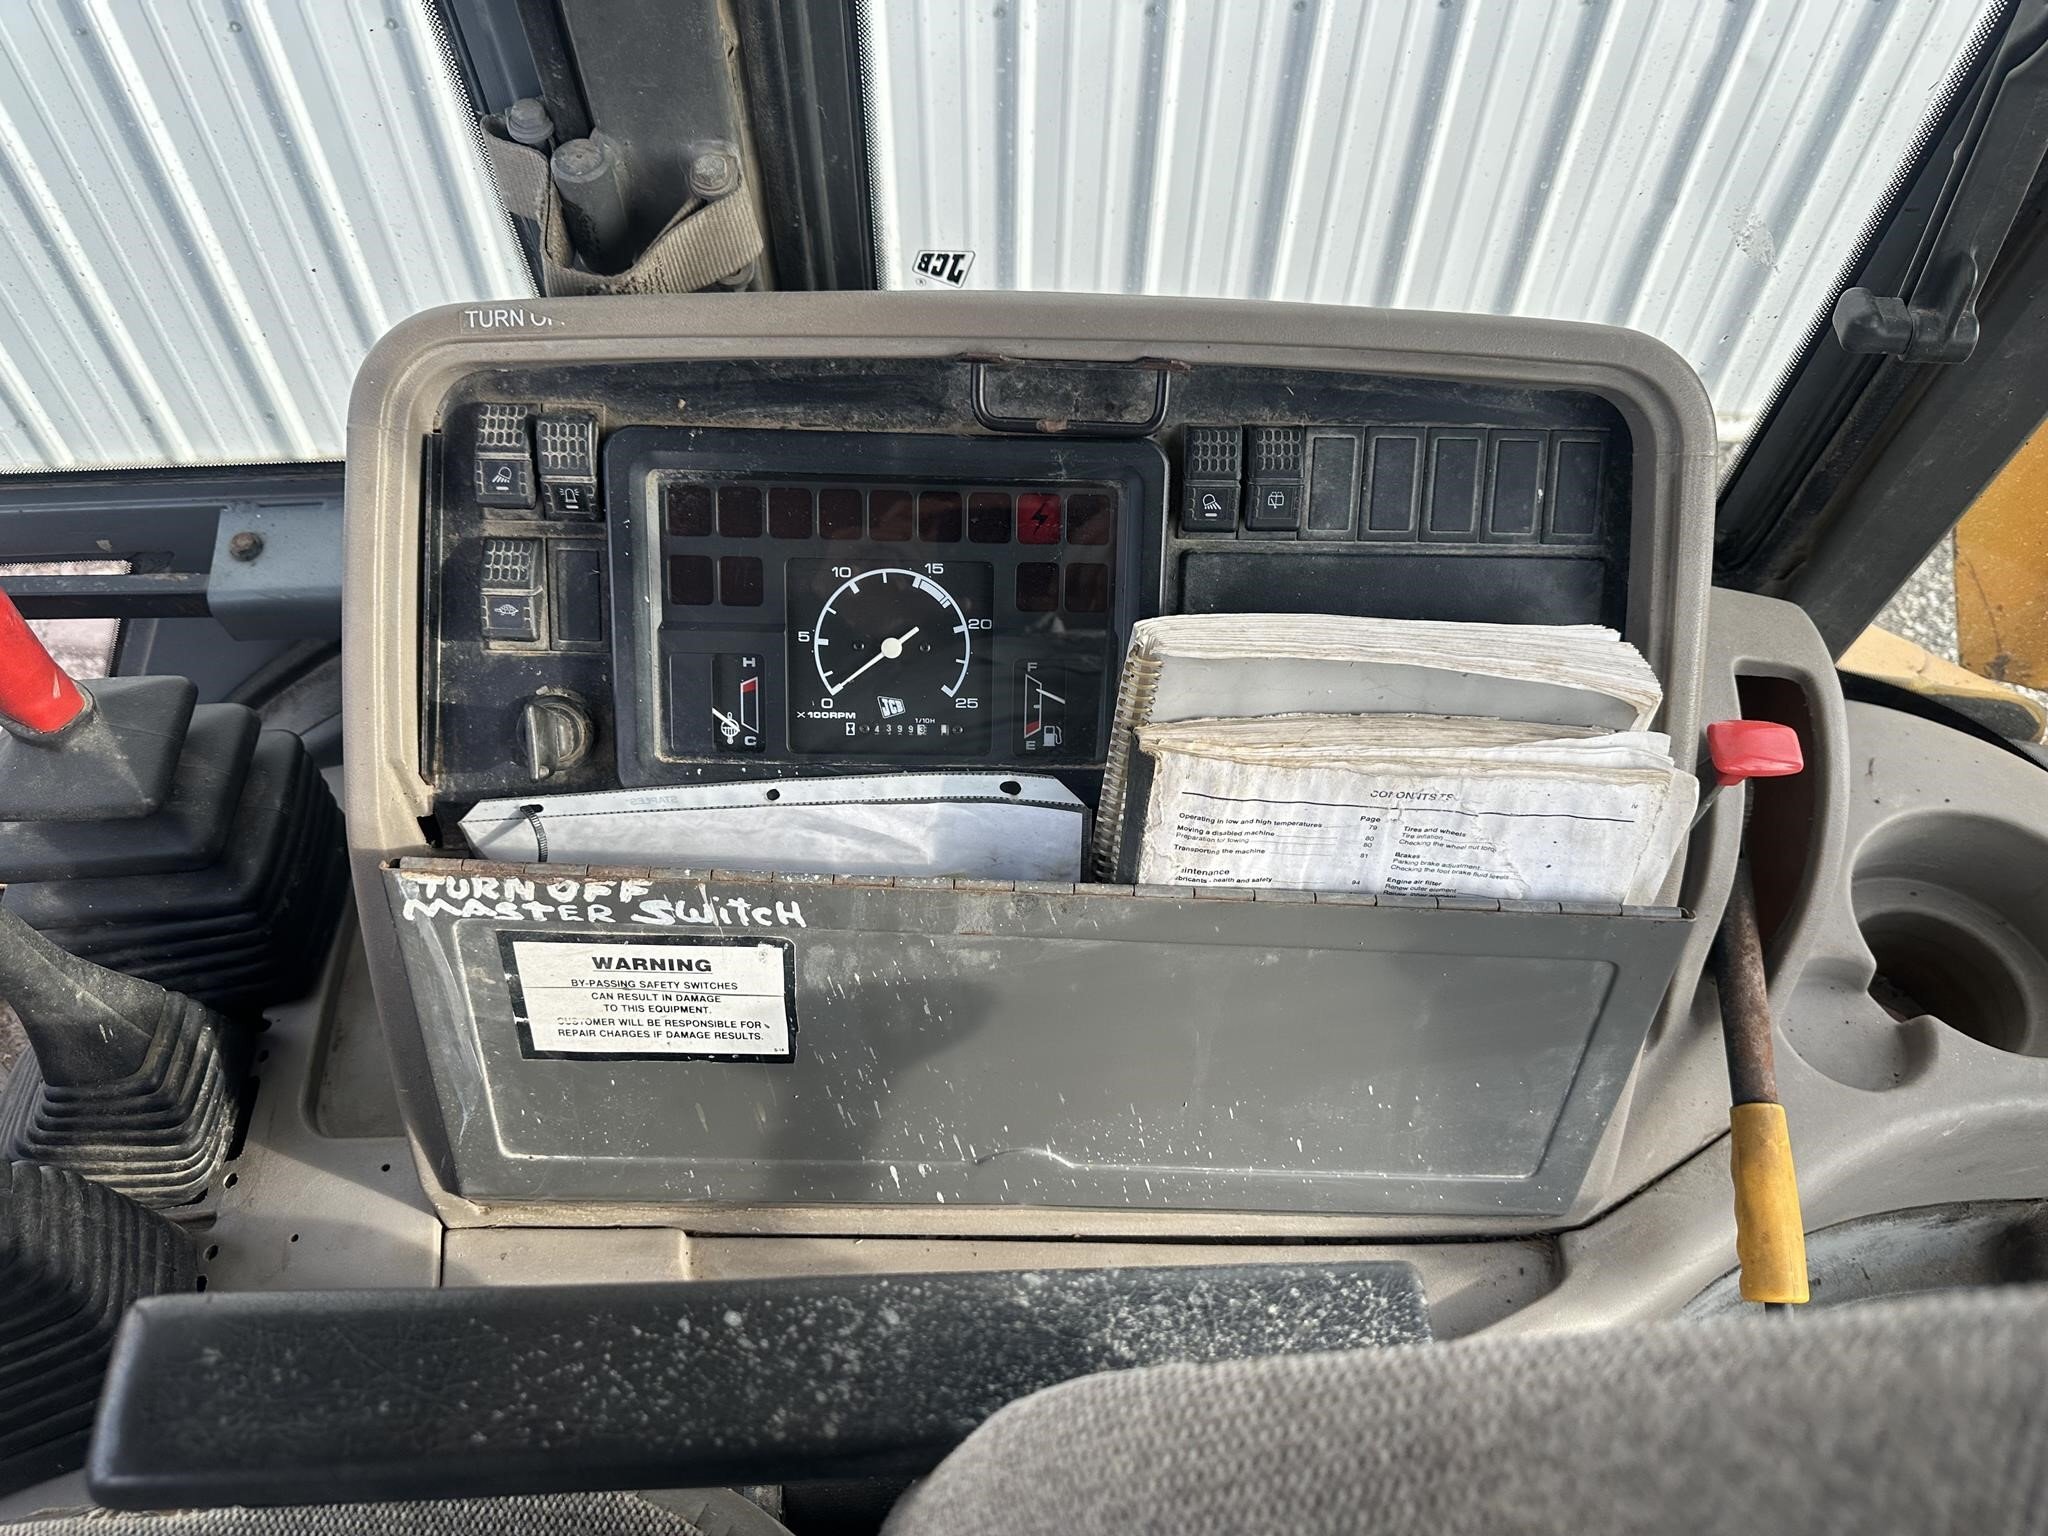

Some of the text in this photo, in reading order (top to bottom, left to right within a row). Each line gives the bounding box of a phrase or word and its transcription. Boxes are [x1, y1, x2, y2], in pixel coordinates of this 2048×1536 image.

[464, 309, 524, 328] TURN
[831, 567, 852, 578] 10
[924, 563, 944, 574] 15
[968, 618, 992, 630] 20
[798, 632, 810, 642] 5
[742, 657, 756, 667] H
[1027, 662, 1038, 672] F
[821, 698, 834, 709] 0
[955, 698, 979, 709] 25
[744, 735, 757, 746] C
[1025, 740, 1036, 750] E
[1179, 812, 1216, 824] Operating
[1255, 818, 1272, 826] high
[1273, 820, 1323, 828] temperatures
[1177, 825, 1204, 835] Moving
[1174, 844, 1220, 855] Transporting
[1387, 877, 1412, 885] Engine
[415, 877, 653, 902] TURN OFF
[403, 899, 616, 923] MASTER
[592, 957, 713, 972] WARNING
[571, 979, 738, 990] BY-PASSING SAFETY SWITCHES
[591, 992, 614, 1000] CAN
[617, 993, 658, 1001] RESULT
[676, 995, 721, 1003] DAMAGE
[603, 1004, 712, 1014] TO THIS EQUIPMENT.
[618, 1018, 644, 1027] WILL
[647, 1019, 661, 1027] BE
[664, 1020, 737, 1029] RESPONSIBLE
[740, 1021, 762, 1029] FOR
[558, 1029, 596, 1037] REPAIR
[599, 1030, 650, 1038] CHARGES
[666, 1031, 711, 1039] DAMAGE
[714, 1032, 764, 1041] RESULTS.
